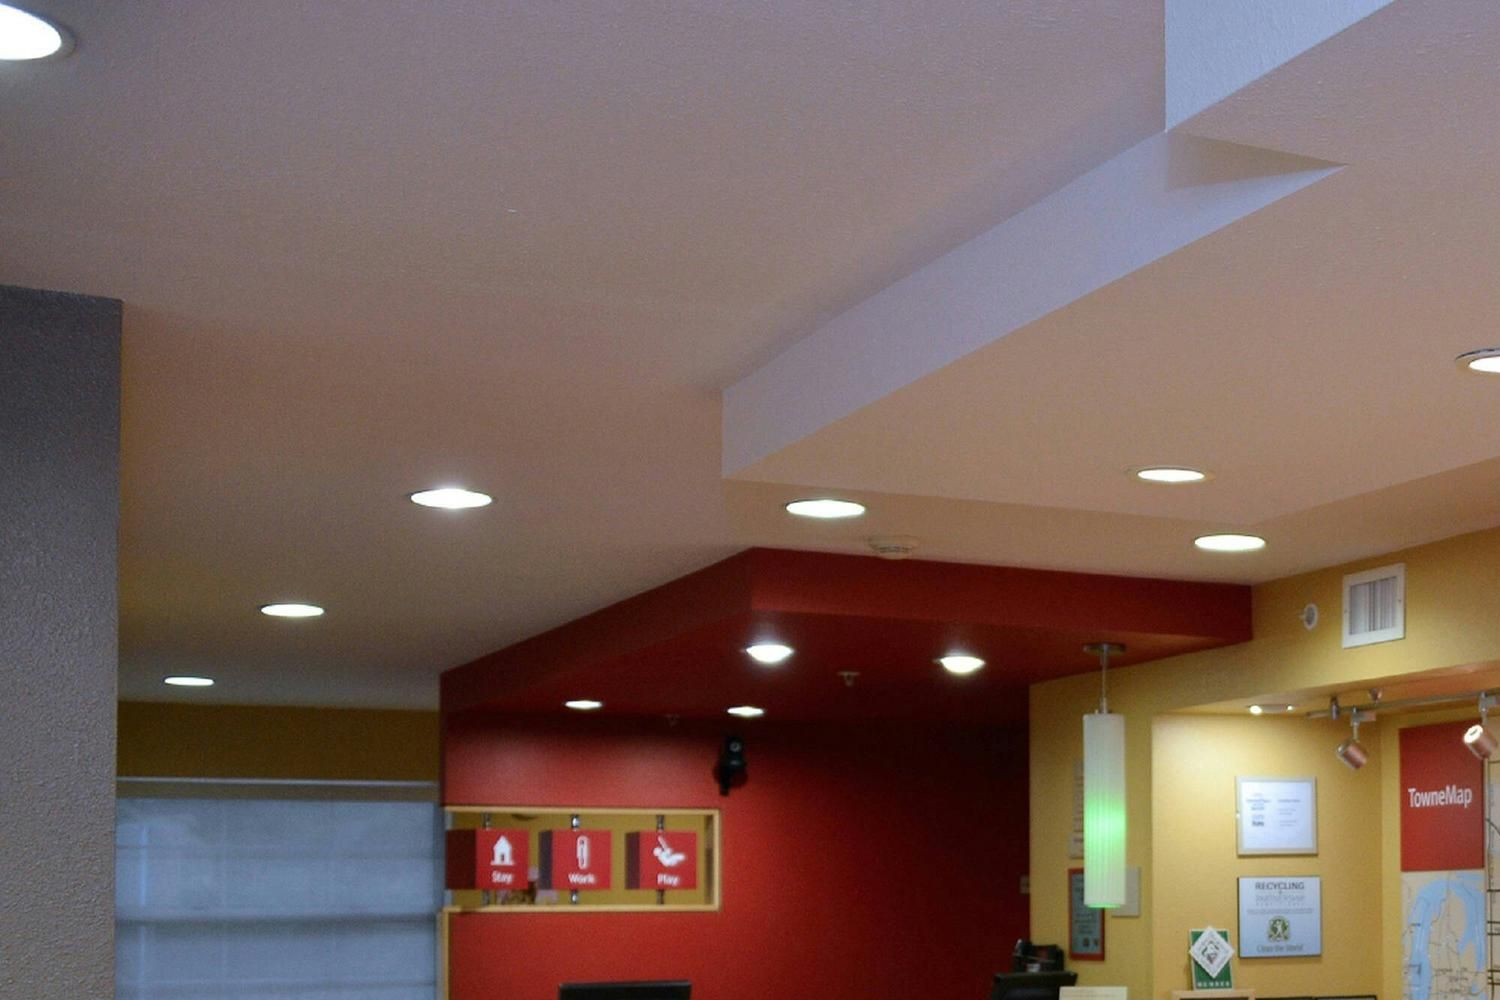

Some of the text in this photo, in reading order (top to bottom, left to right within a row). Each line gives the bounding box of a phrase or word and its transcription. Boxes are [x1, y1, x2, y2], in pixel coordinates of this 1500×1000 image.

[1407, 784, 1474, 809] TowneMap
[492, 872, 513, 885] Stay
[568, 873, 596, 885] Work
[657, 874, 680, 886] Play
[1255, 881, 1305, 890] RECYCLING
